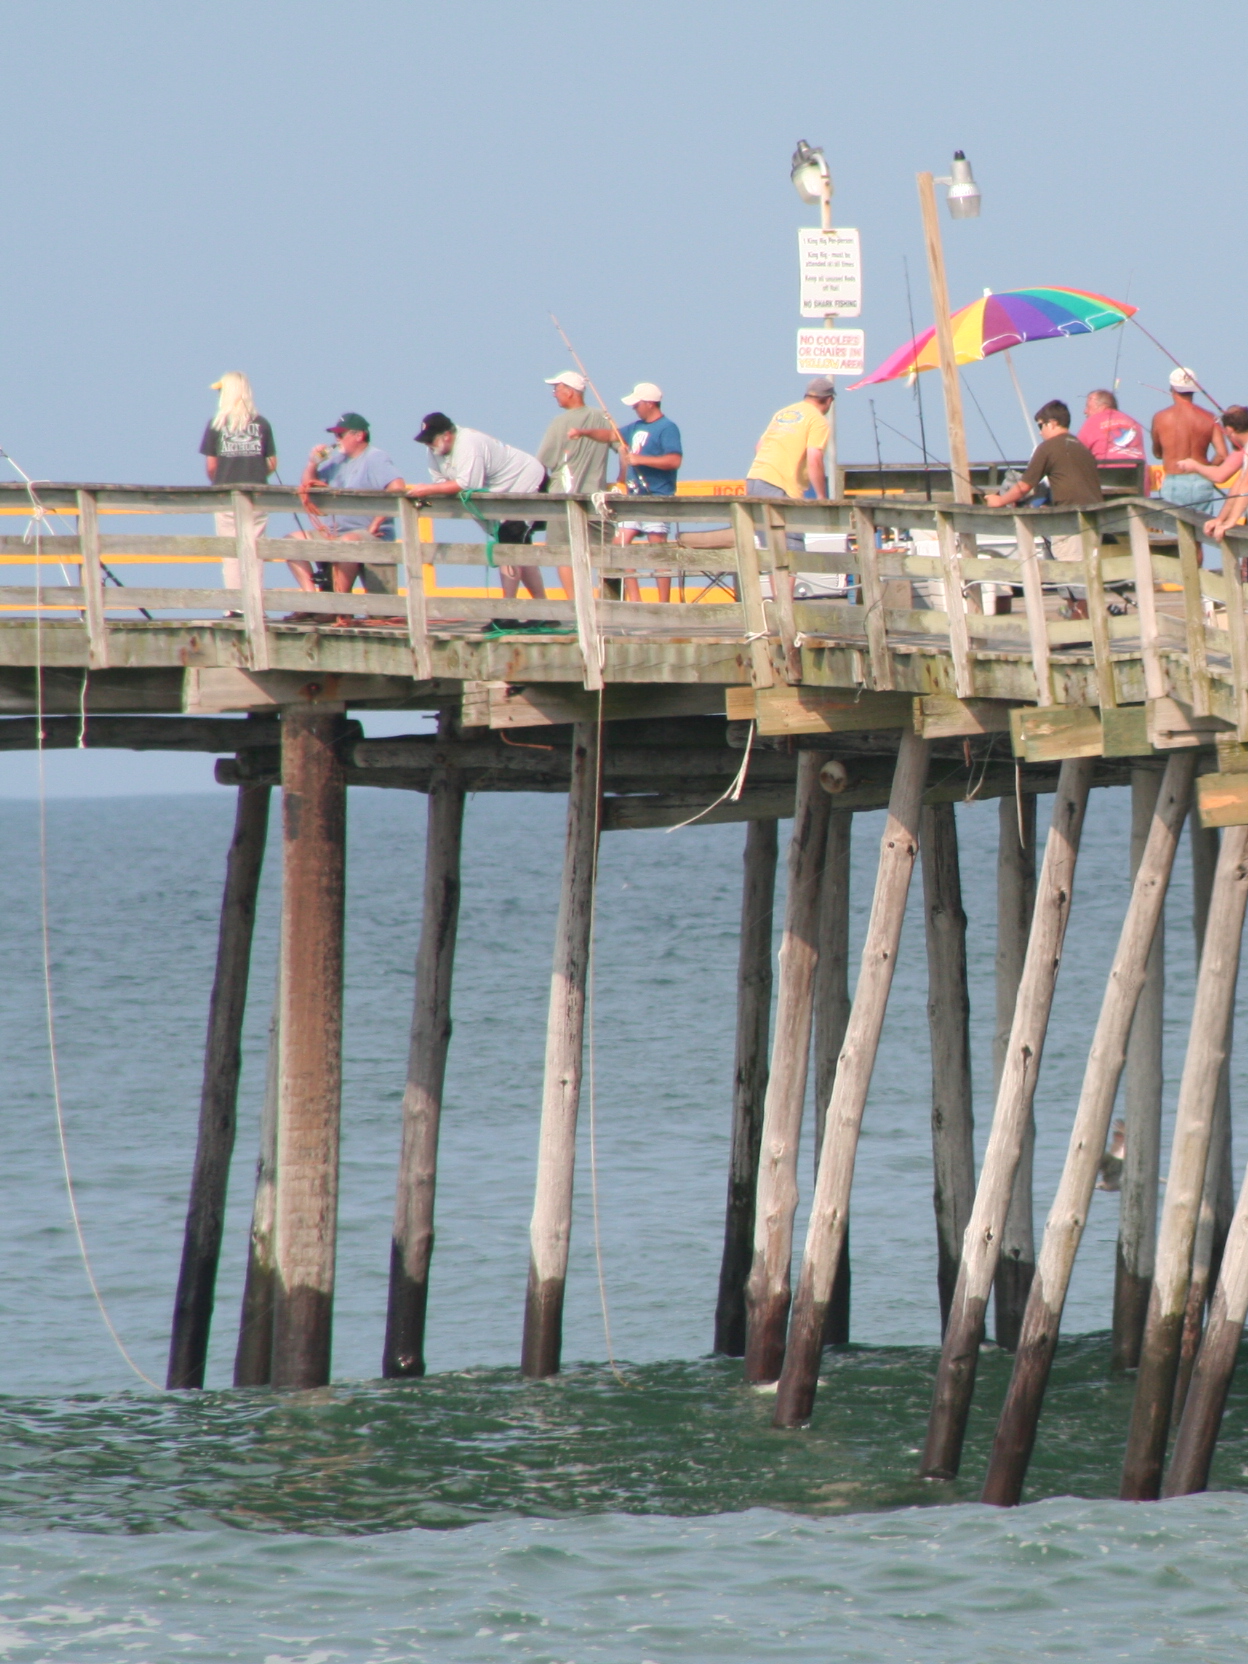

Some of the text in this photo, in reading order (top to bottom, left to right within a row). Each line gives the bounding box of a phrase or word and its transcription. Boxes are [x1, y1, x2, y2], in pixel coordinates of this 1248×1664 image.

[803, 300, 858, 308] NO SHARK FISHING
[800, 335, 861, 345] NO COOLERS
[799, 347, 862, 357] OR CHAIRS IN
[799, 358, 864, 369] YELLOW AREA
